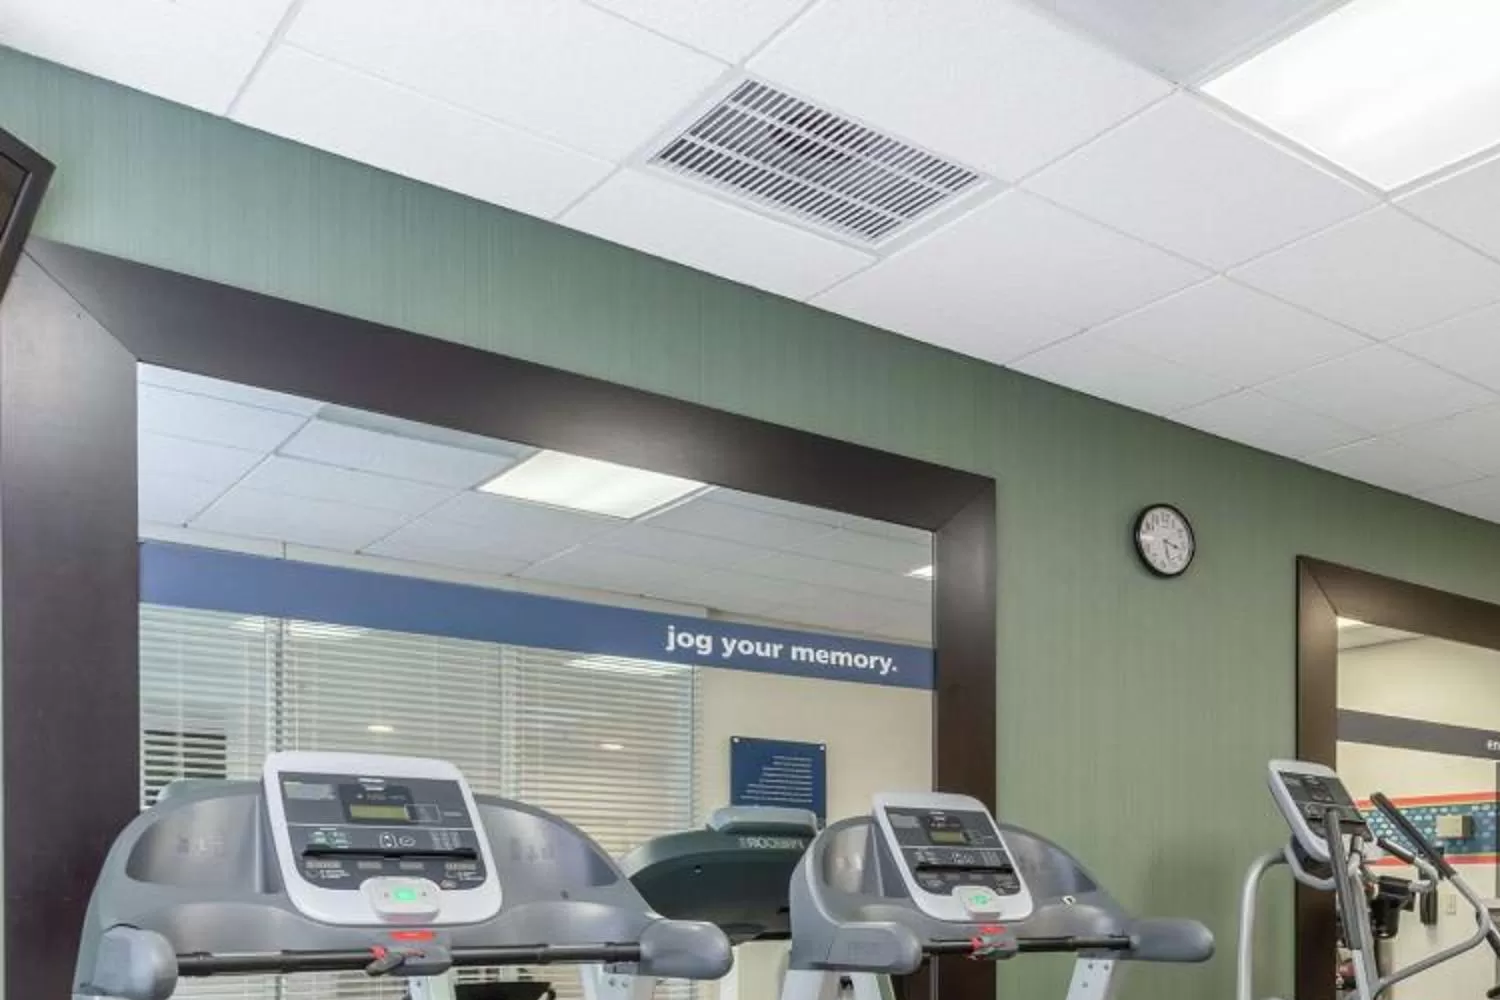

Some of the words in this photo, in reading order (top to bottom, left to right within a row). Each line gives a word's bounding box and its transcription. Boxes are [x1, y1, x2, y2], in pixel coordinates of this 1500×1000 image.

[666, 625, 713, 655] jog
[721, 636, 783, 658] your
[791, 645, 898, 673] memory.
